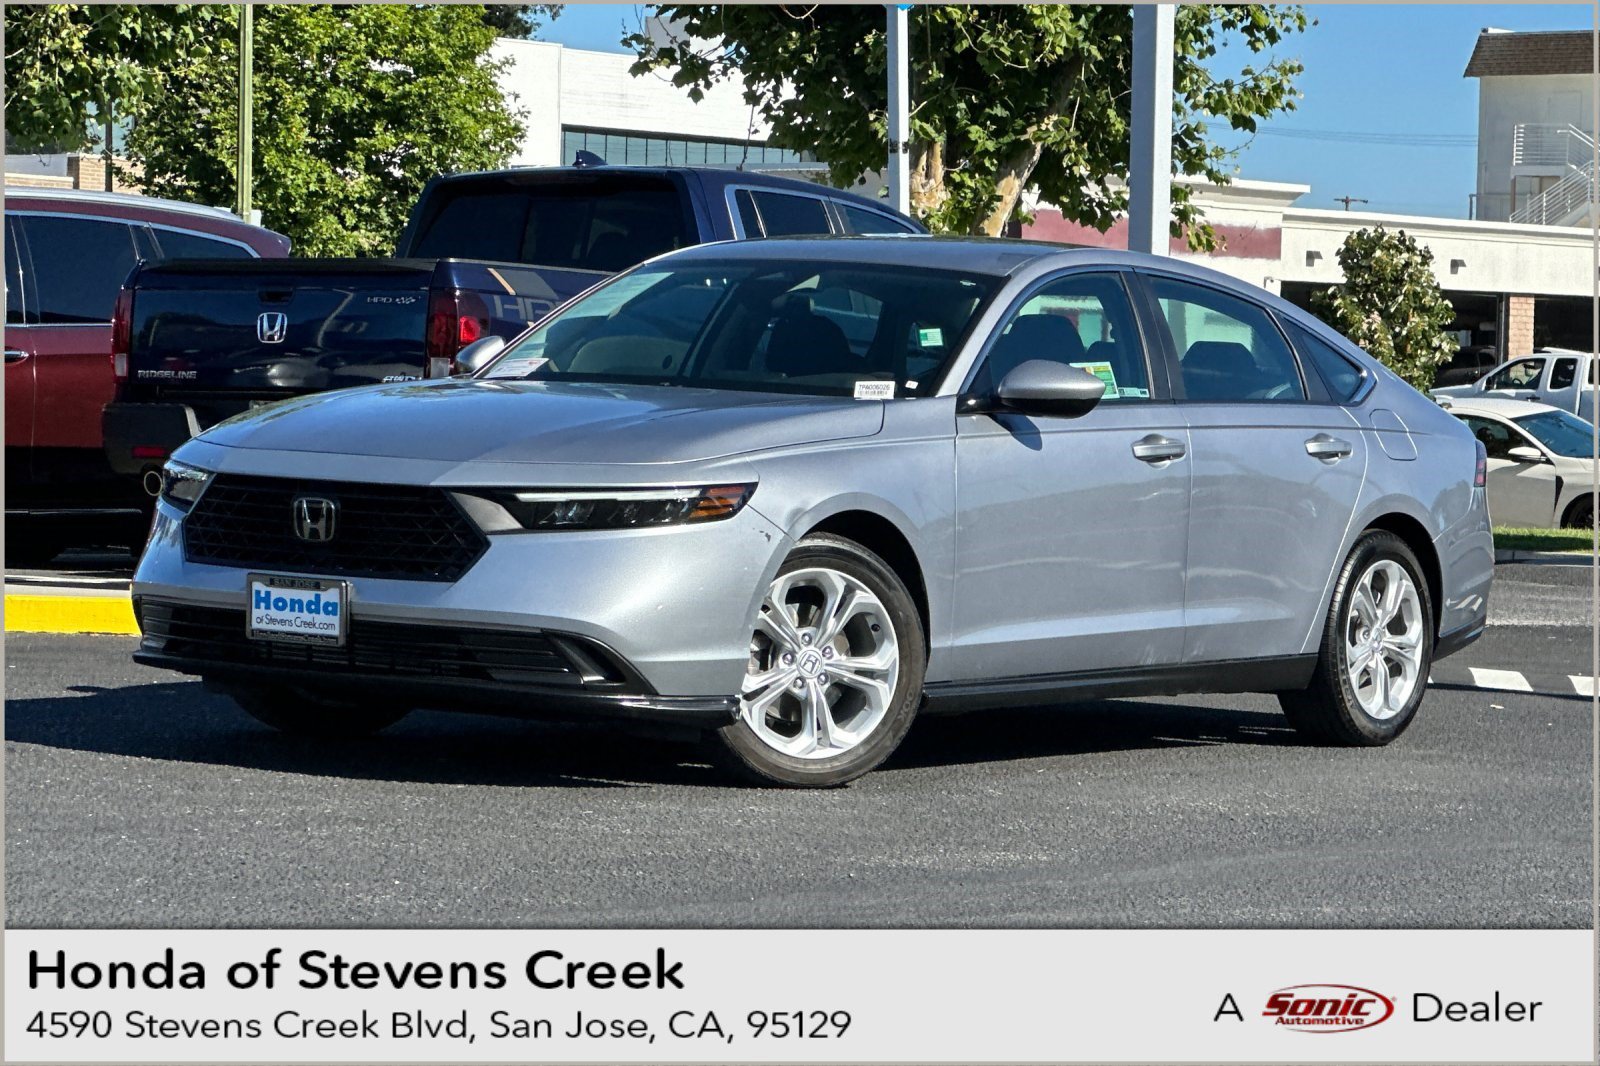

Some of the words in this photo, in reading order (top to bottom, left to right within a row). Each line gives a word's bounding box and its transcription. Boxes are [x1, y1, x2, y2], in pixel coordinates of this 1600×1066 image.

[138, 369, 198, 379] RIDGELINE
[254, 589, 338, 616] Honda
[256, 615, 264, 625] of
[265, 613, 293, 627] Stevens
[294, 616, 336, 631] Creek.com
